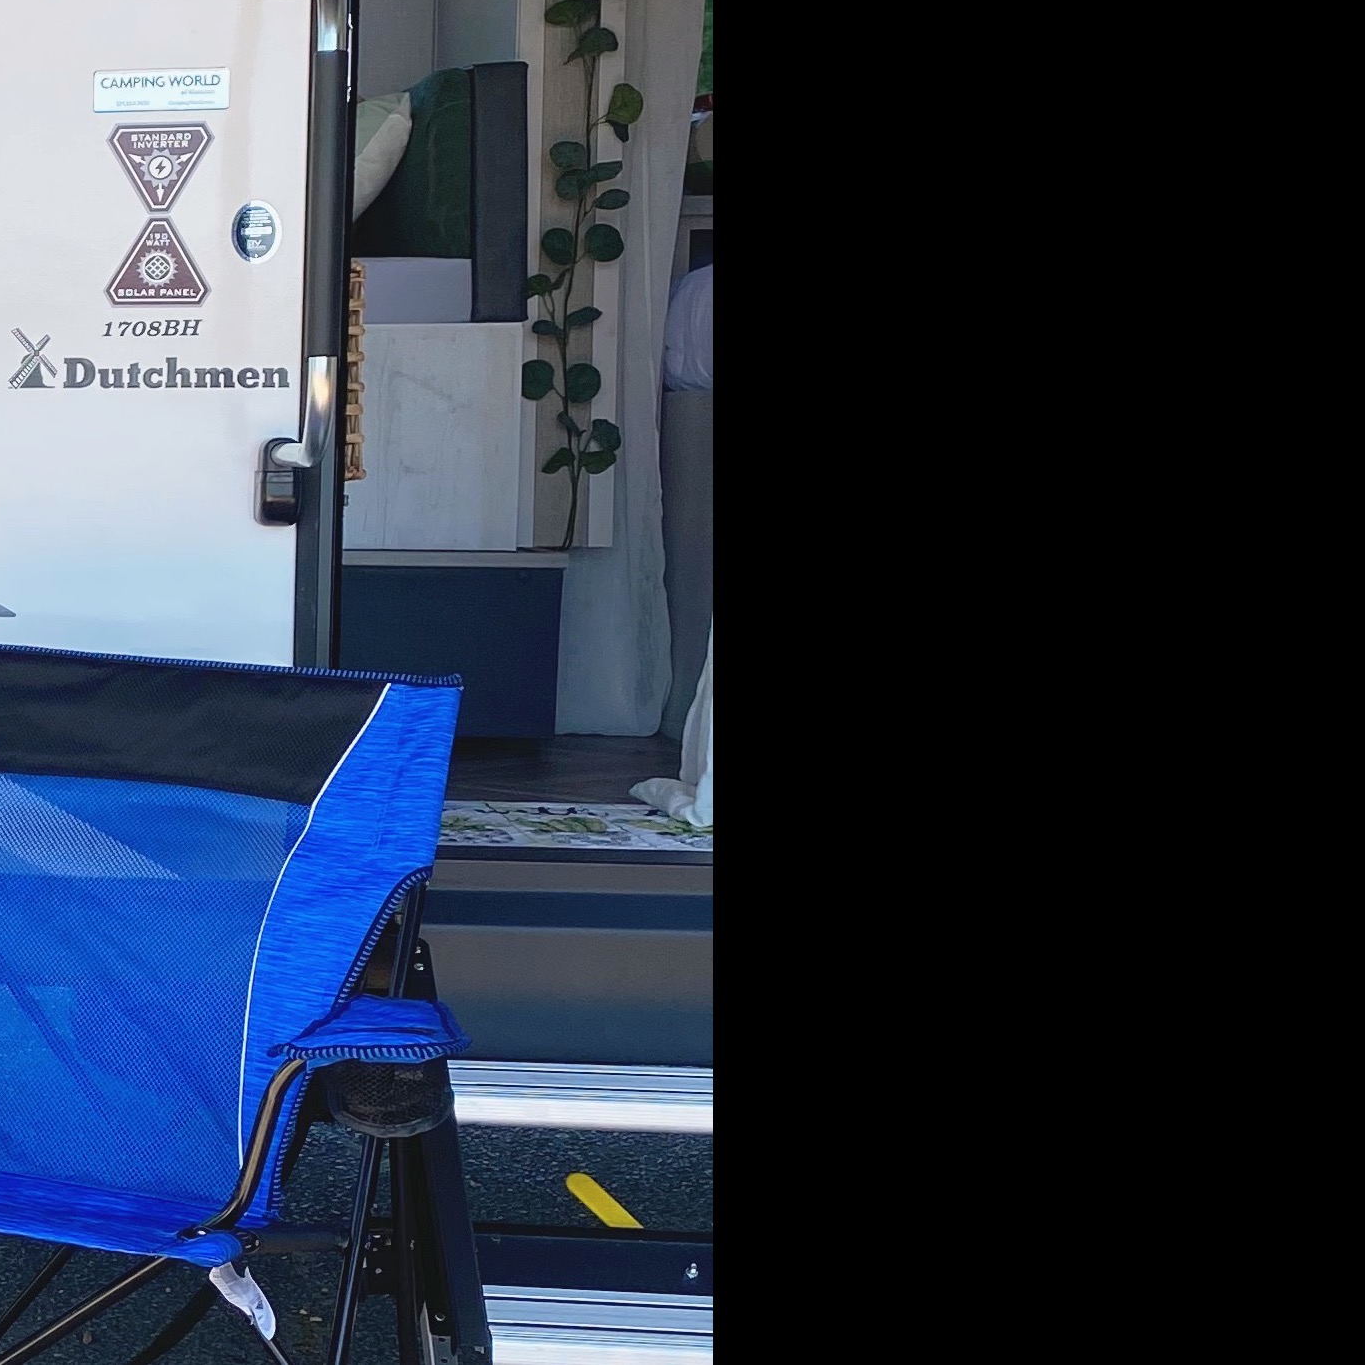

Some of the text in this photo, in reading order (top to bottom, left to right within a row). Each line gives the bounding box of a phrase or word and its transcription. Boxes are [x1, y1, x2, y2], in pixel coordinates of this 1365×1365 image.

[100, 75, 221, 89] CAMPING WORLD
[131, 132, 192, 142] STANDARD
[133, 140, 189, 149] INVERTER
[145, 239, 171, 247] WATT
[117, 288, 197, 297] SOLAR PANEL
[102, 318, 203, 337] 1708BH
[63, 357, 290, 388] Dutchmen
